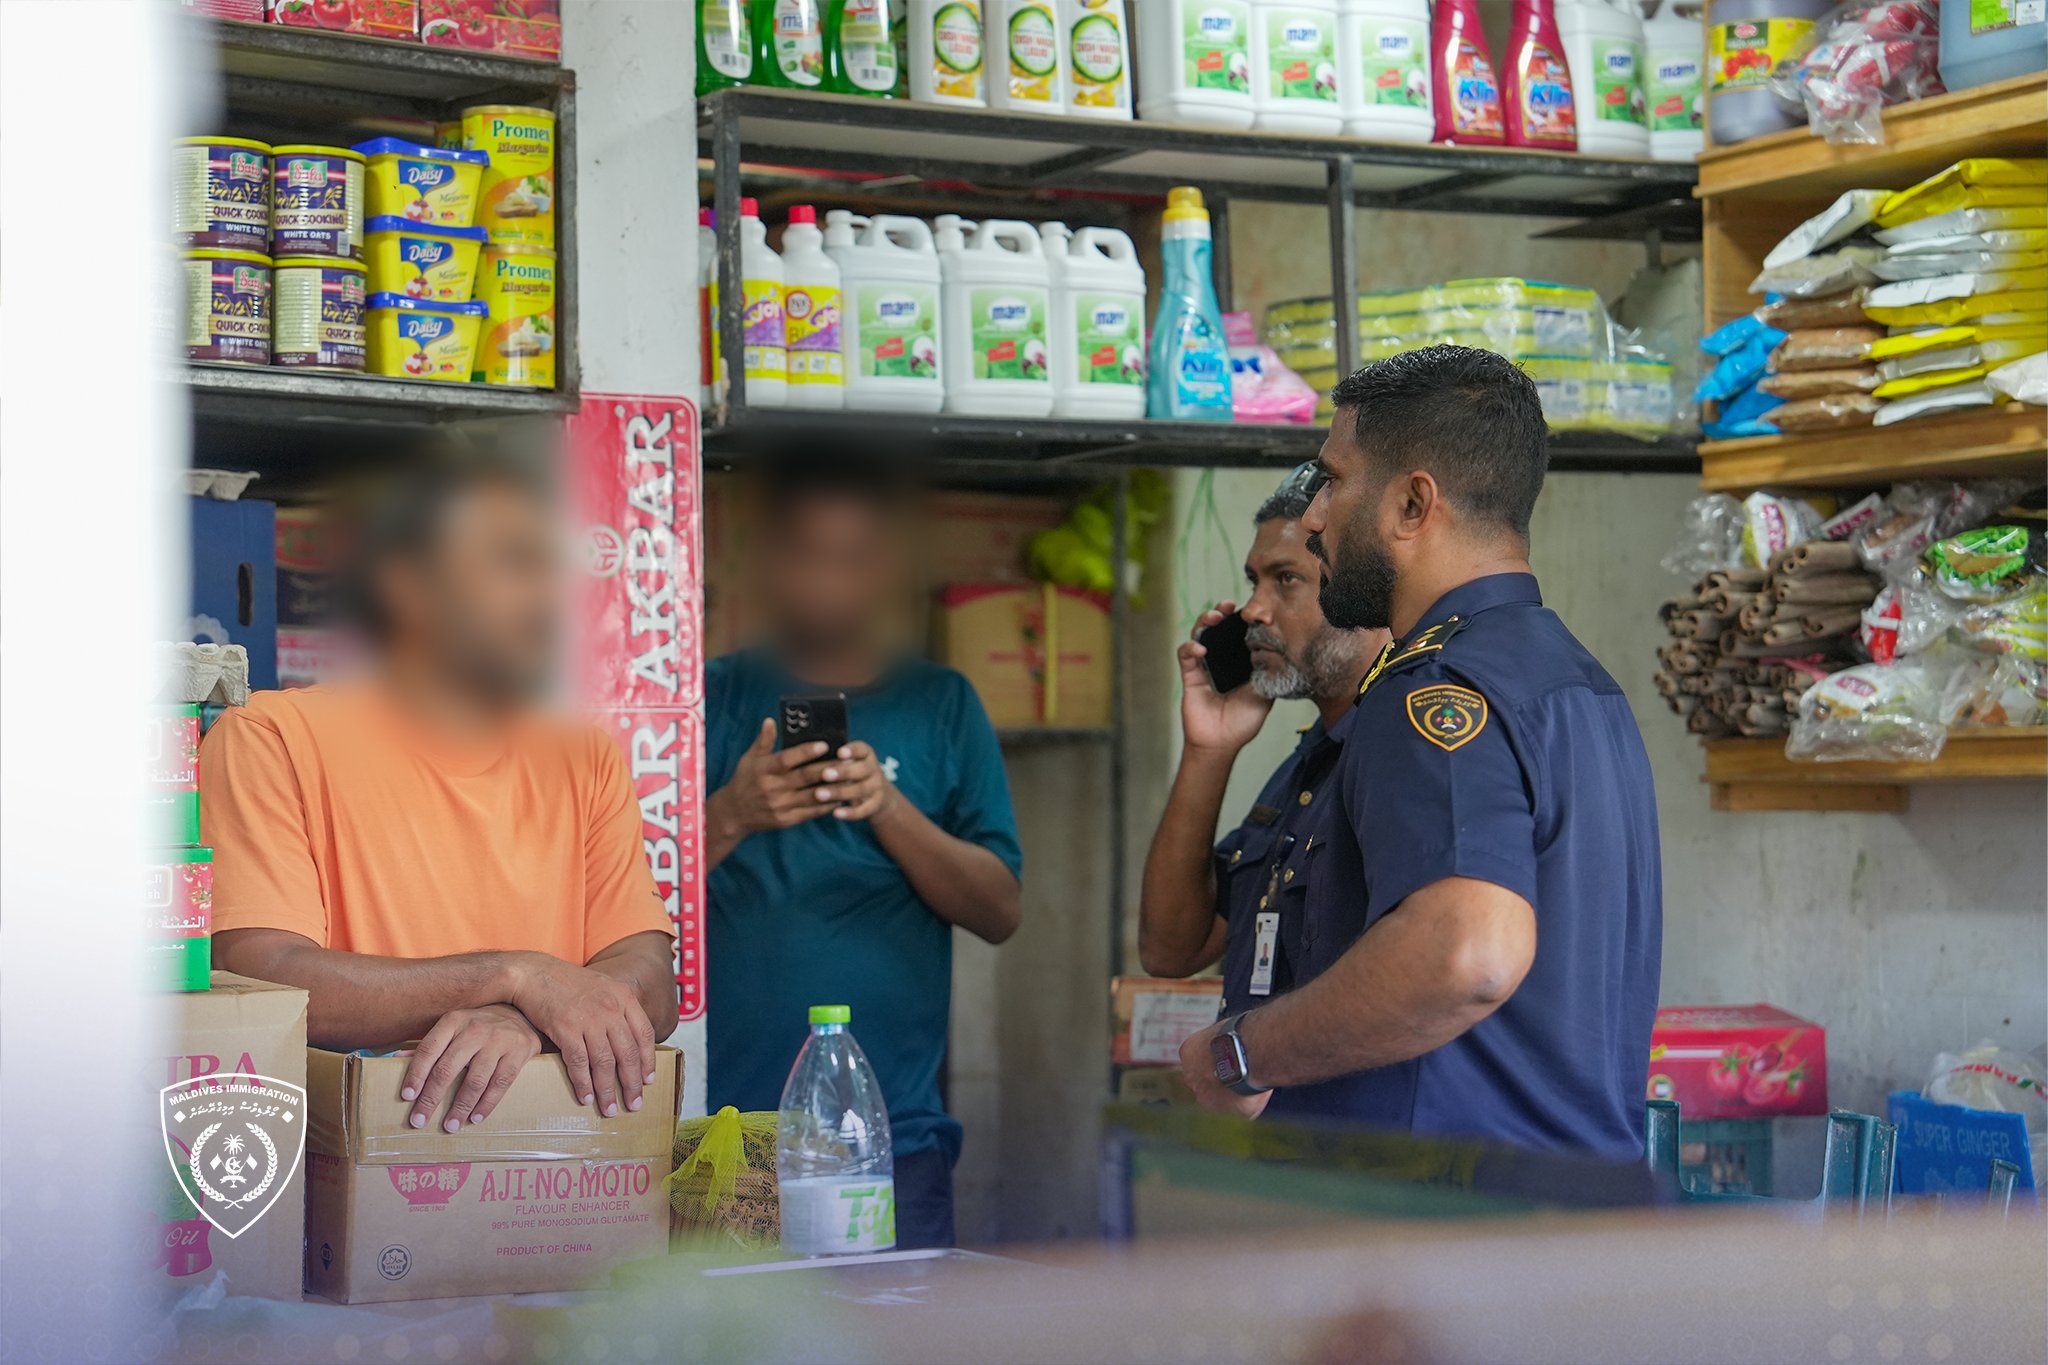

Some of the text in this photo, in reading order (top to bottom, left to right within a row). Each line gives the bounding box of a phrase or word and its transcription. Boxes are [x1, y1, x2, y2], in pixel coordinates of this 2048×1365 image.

[408, 167, 444, 185] Daisy
[213, 205, 243, 218] QUICK
[225, 223, 252, 233] WHITE
[275, 214, 298, 226] QUICK
[283, 230, 332, 240] WHITE OATS
[408, 244, 443, 263] Daisy
[215, 320, 246, 333] QUICK
[325, 327, 351, 340] QUICK
[408, 320, 443, 338] Daisy
[227, 338, 254, 348] WHITE
[675, 407, 687, 449] TEA
[677, 468, 690, 571] QUALITY
[625, 410, 679, 694] AKBAR
[680, 716, 696, 1011] PREMIUM QUALITY TEA
[1914, 1119, 2012, 1157] SUPER GINGER
[515, 1200, 630, 1216] FLAVOUR ENHANCER
[491, 1214, 649, 1230] 99% PURE MONOSODIUM GLUTAMATE
[164, 1227, 200, 1248] Oil
[496, 1243, 592, 1256] PRODUCT OF CHINA
